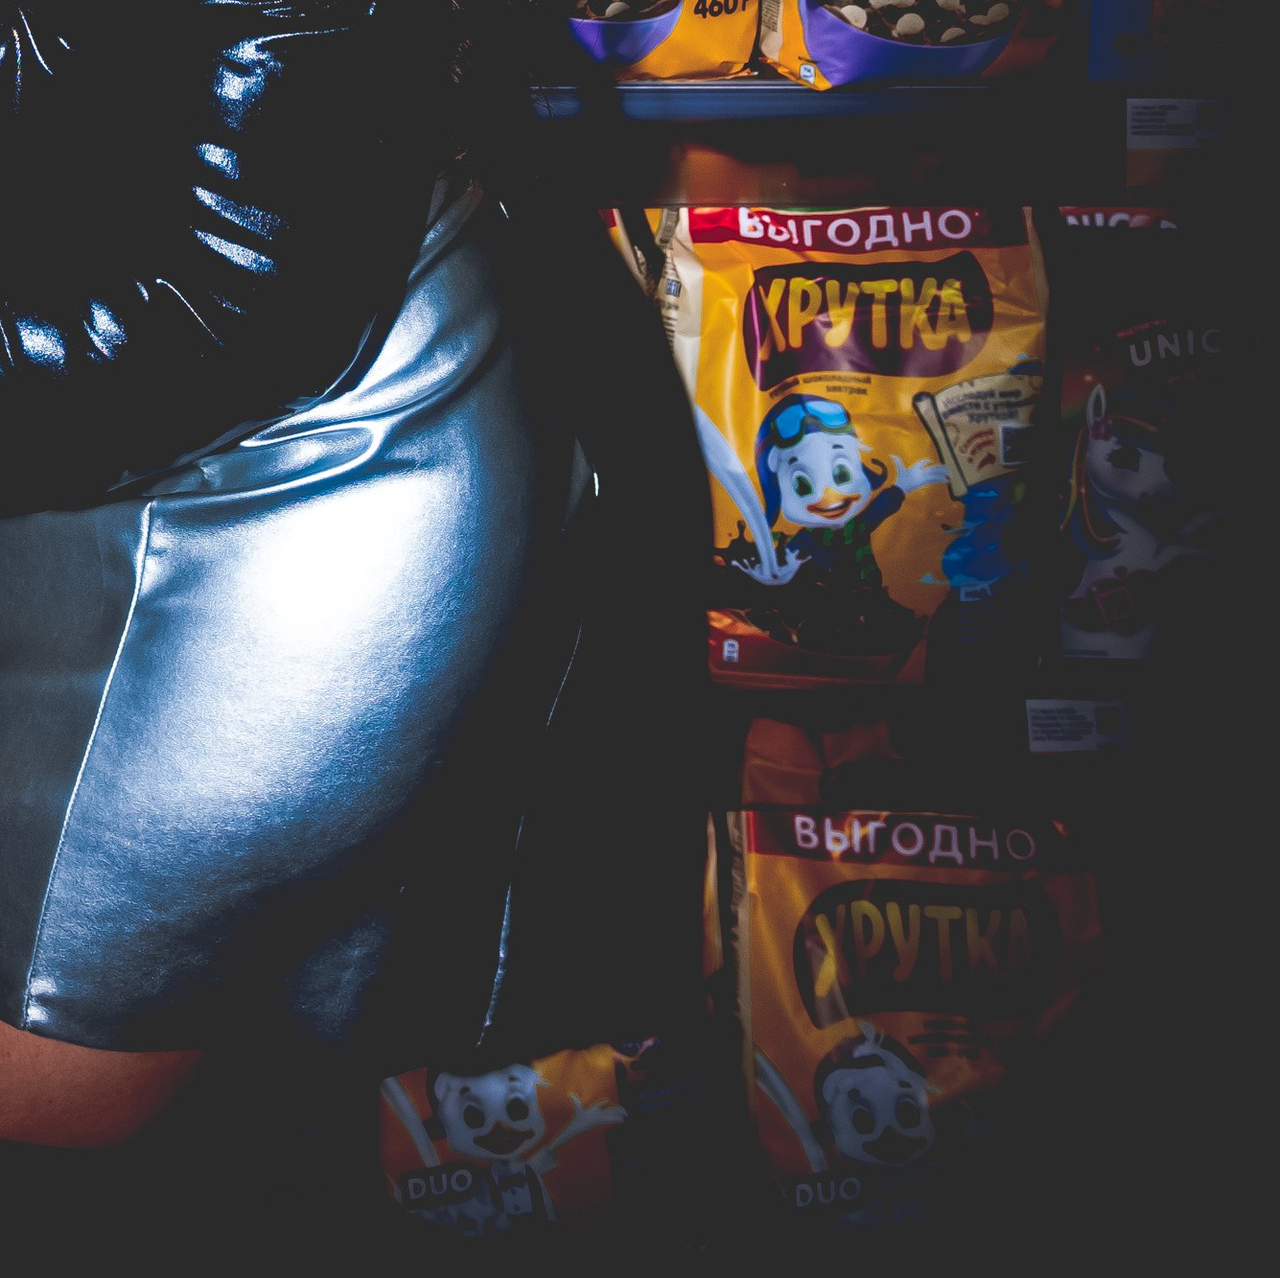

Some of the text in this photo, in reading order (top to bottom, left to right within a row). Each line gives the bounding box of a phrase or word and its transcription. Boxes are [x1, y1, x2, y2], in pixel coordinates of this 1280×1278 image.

[738, 207, 972, 251] ВЫГОДНО
[758, 276, 972, 362] ХРУТКА
[793, 814, 1037, 865] ВЫГОДНО
[814, 899, 1034, 999] ХРУТКА
[406, 1169, 473, 1201] DUO
[795, 1175, 862, 1209] DUO
